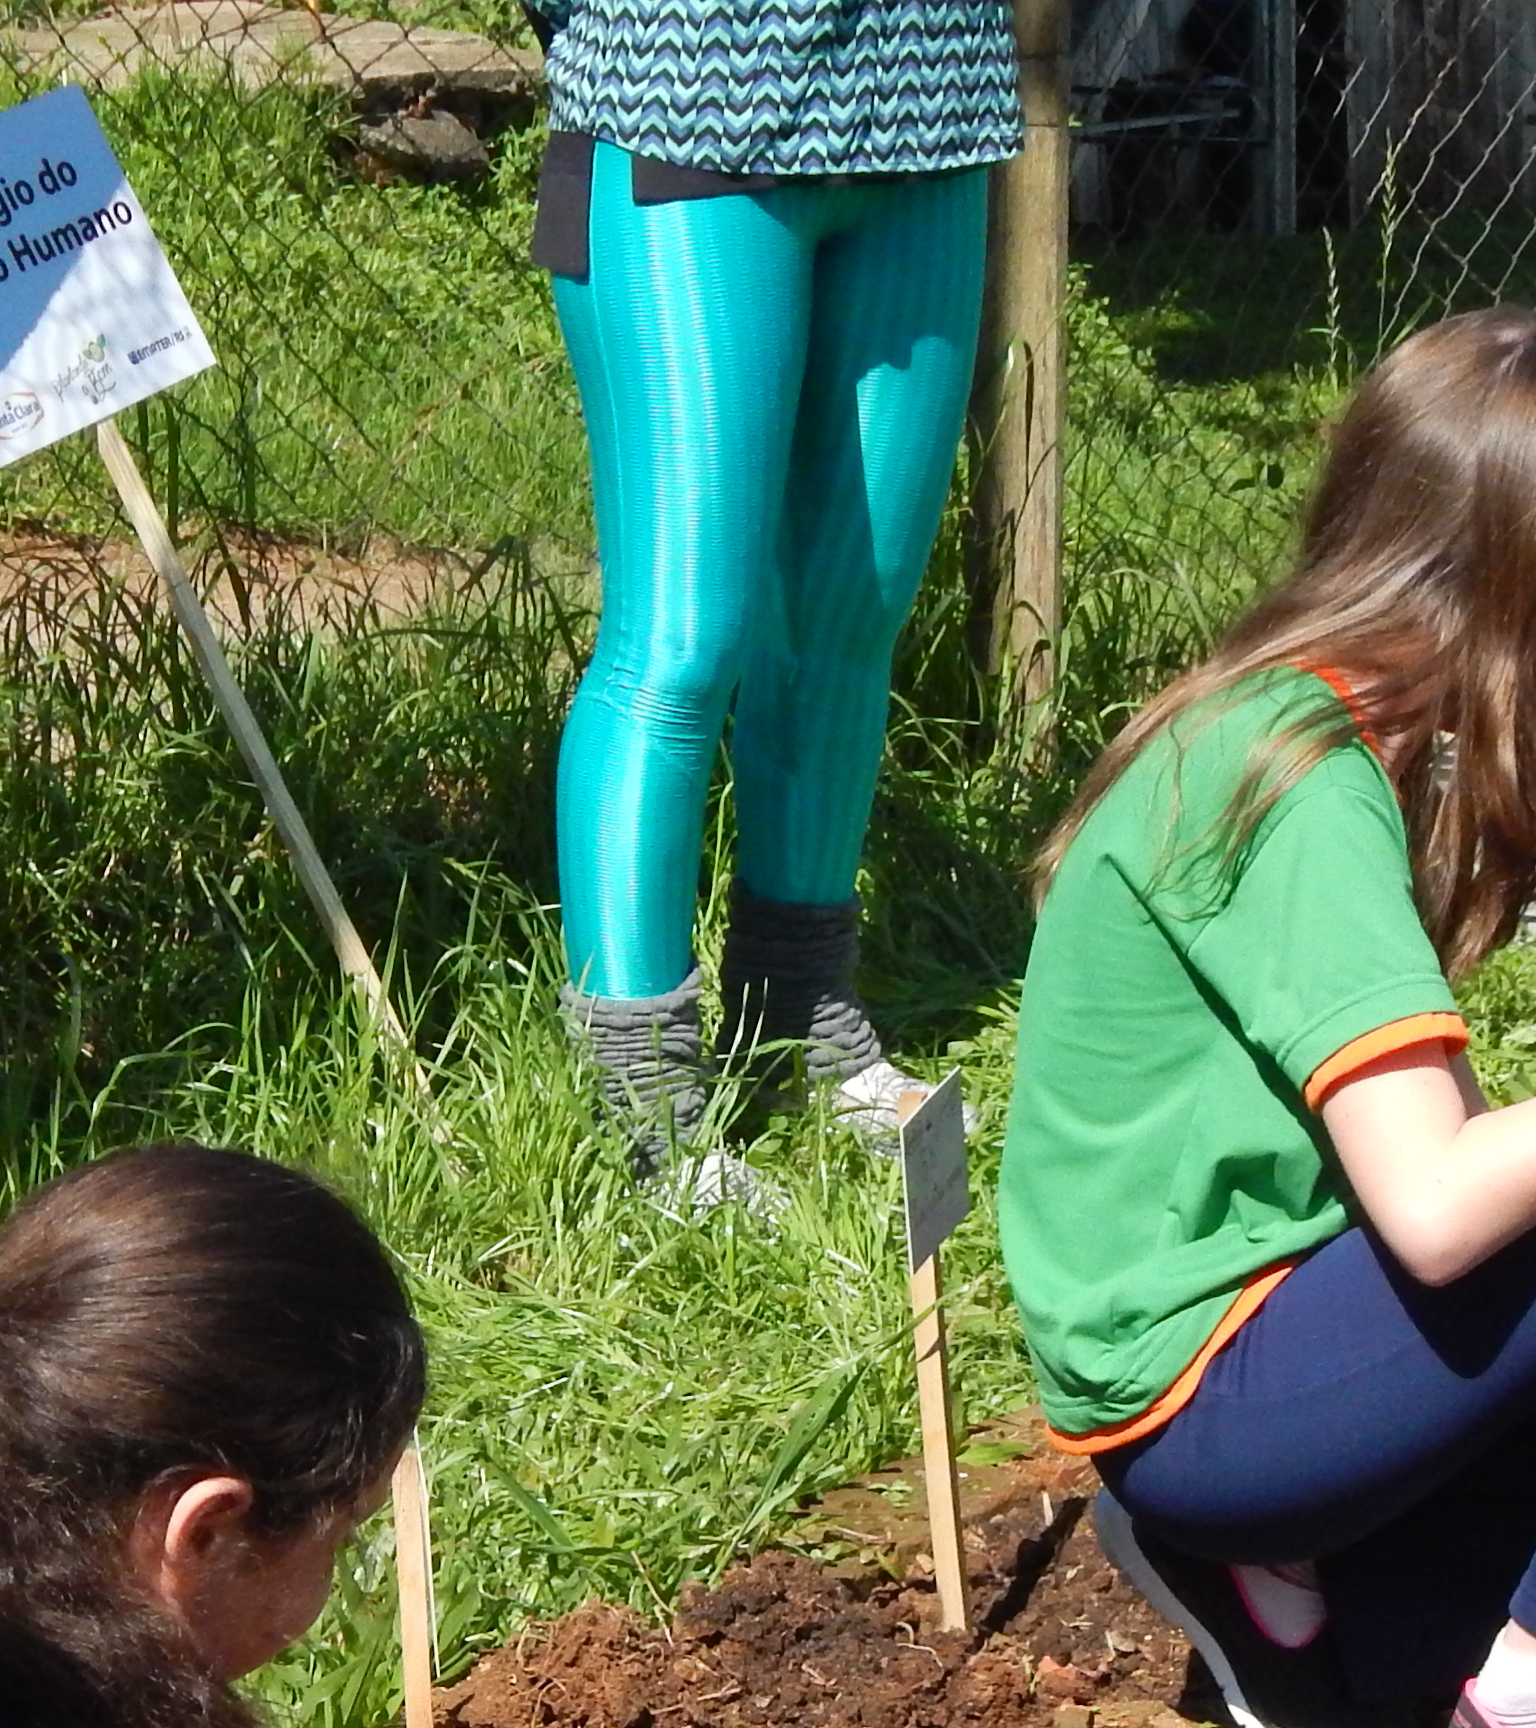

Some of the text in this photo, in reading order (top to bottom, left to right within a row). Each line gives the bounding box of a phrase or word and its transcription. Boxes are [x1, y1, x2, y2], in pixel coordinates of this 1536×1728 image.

[38, 157, 77, 194] do
[7, 201, 133, 272] Humano
[16, 401, 40, 420] Clara
